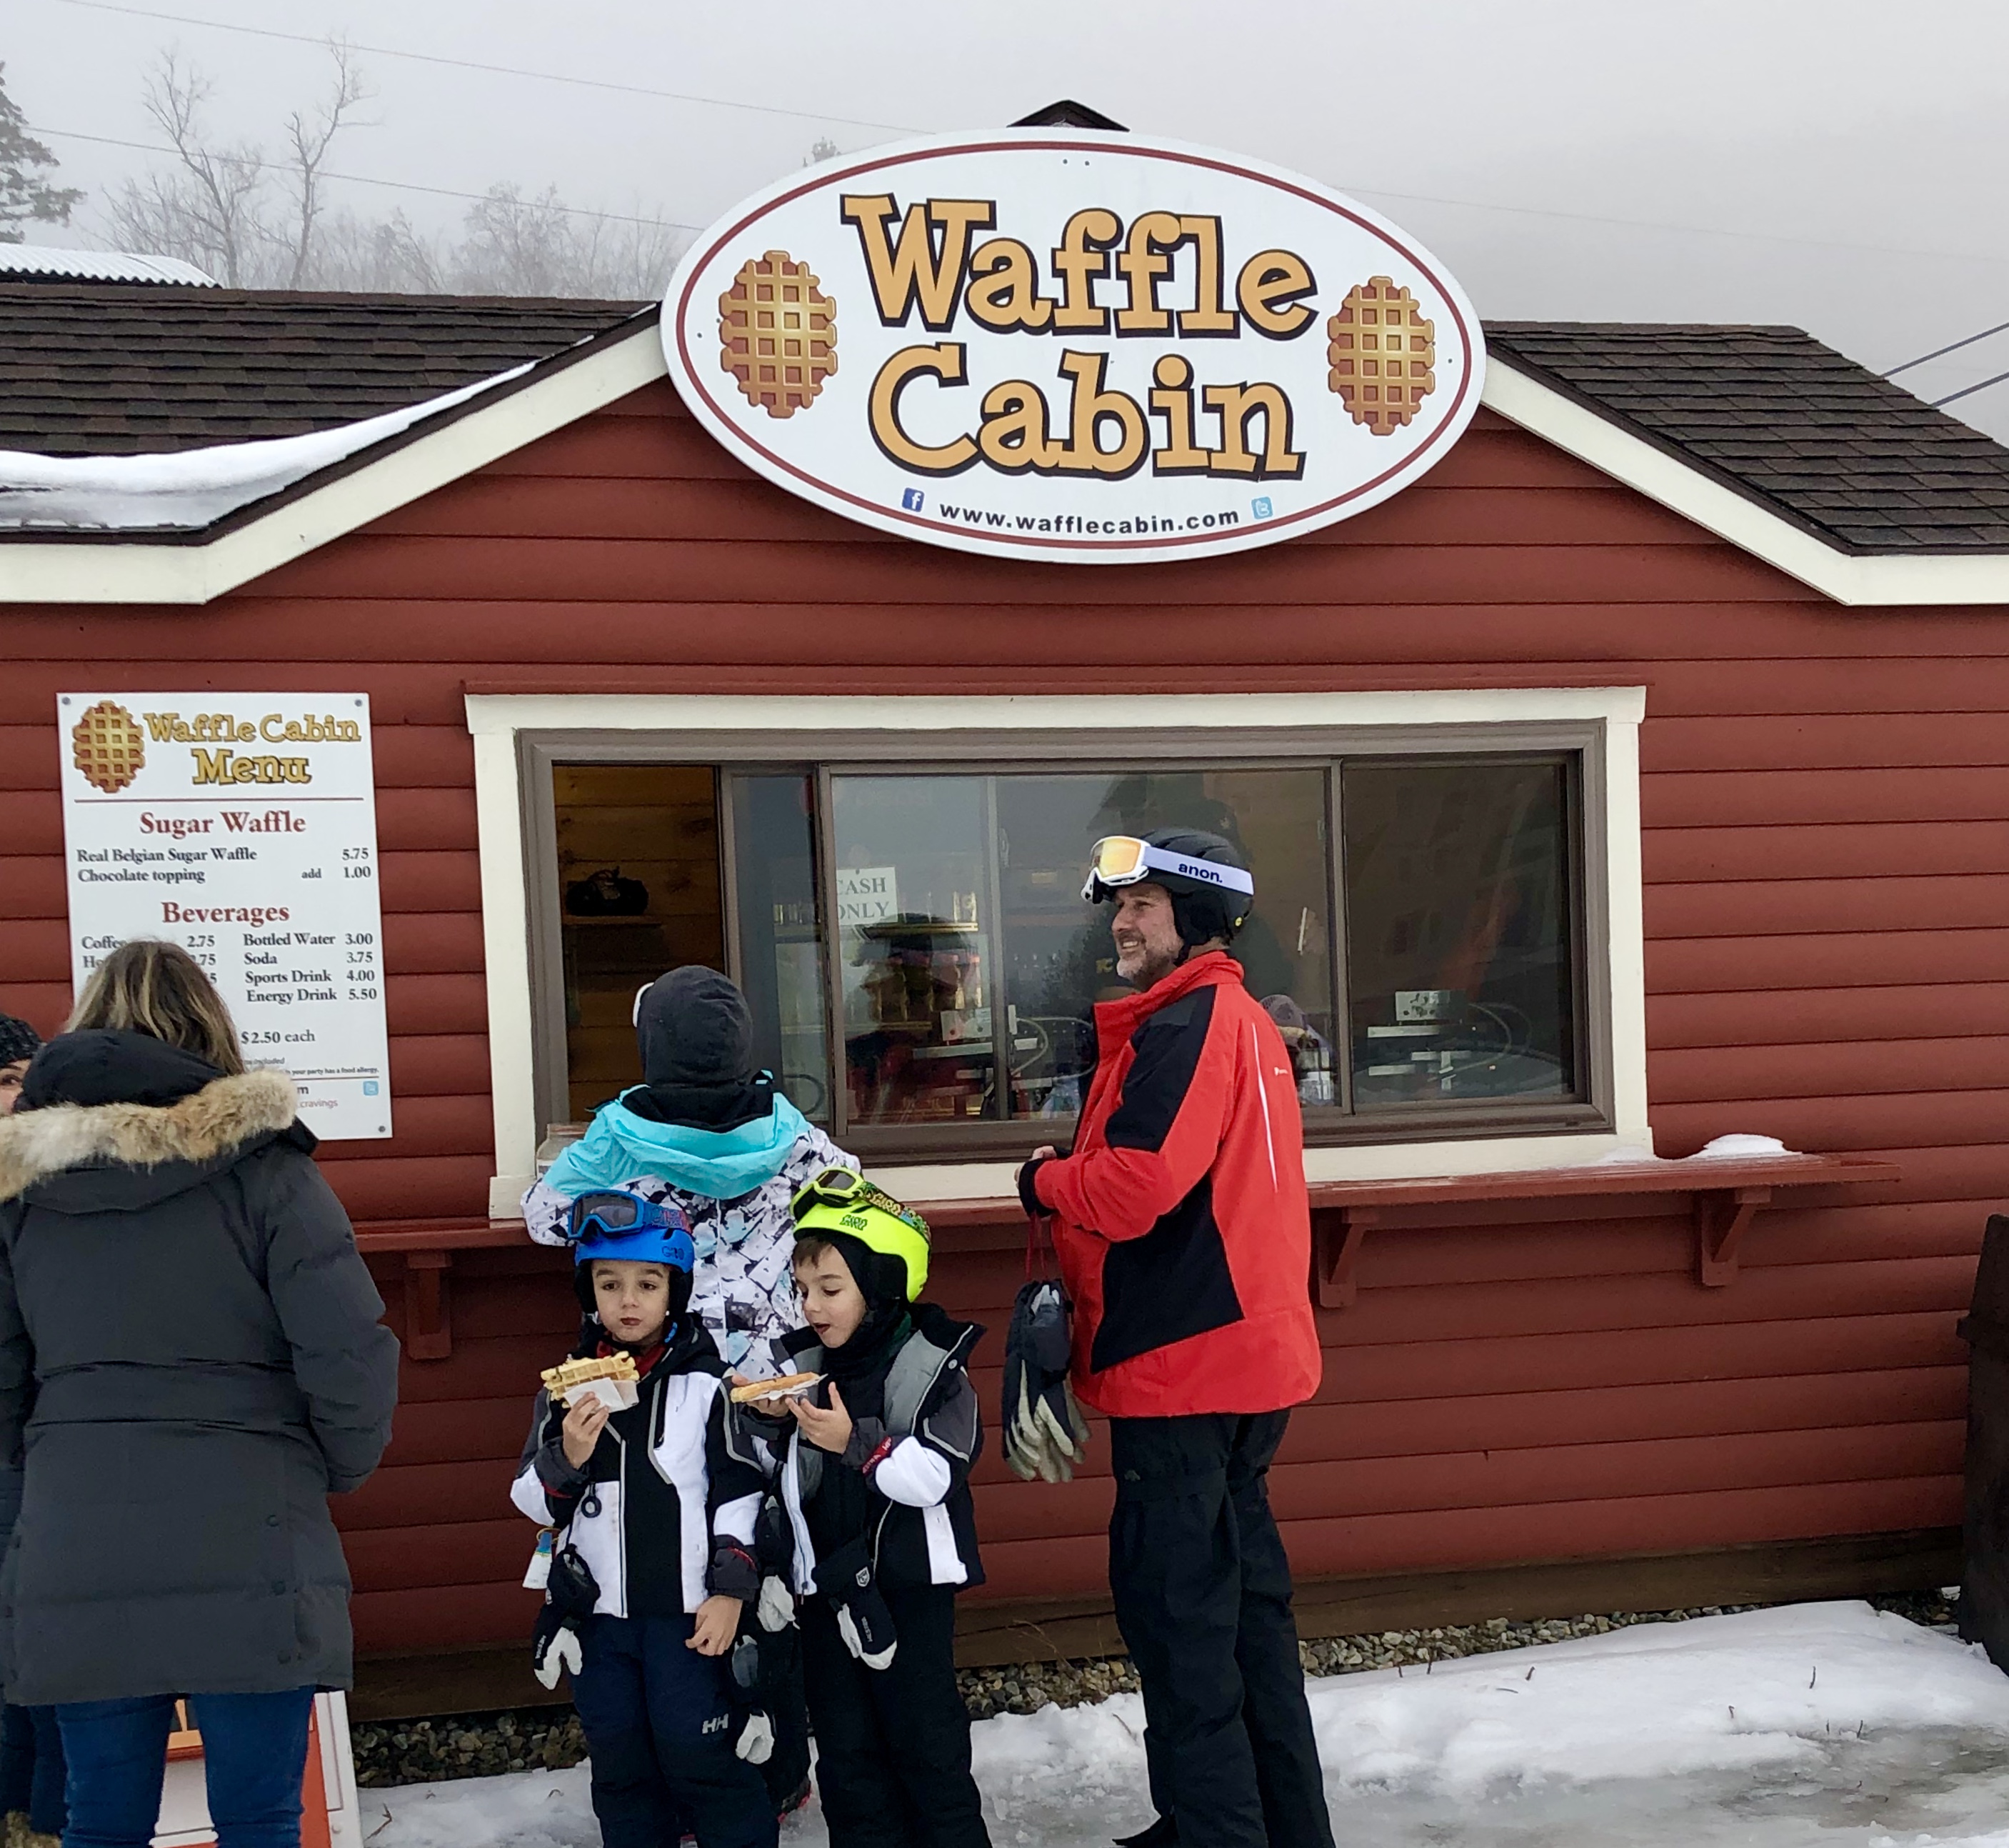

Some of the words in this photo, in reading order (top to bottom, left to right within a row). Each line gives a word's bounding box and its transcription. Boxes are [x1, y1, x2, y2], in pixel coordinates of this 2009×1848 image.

[840, 193, 1318, 341] Waffle
[867, 341, 1307, 482] Cabin
[940, 503, 1240, 534] www.wafflecabin.com
[144, 713, 256, 743] Waffle
[260, 714, 361, 743] Cabin
[191, 748, 313, 786] Menu
[140, 811, 213, 840] Sugar
[220, 810, 306, 833] Waffle
[76, 849, 108, 862] Real
[112, 848, 165, 865] Belgian
[168, 847, 208, 864] Sugar
[211, 847, 257, 861] Waffle
[342, 848, 369, 861] 5.75
[78, 868, 149, 882] Chocolate
[153, 868, 205, 884] topping
[301, 868, 322, 879] add
[344, 866, 371, 879] 1.00
[1178, 863, 1223, 883] anon.
[161, 901, 290, 928] Beverages
[187, 935, 215, 947] 2.75
[243, 932, 291, 946] Bottled
[294, 932, 336, 945] Water
[345, 933, 373, 945] 3.00
[83, 955, 105, 969] Ho
[244, 952, 277, 964] Soda
[346, 952, 373, 963] 3.75
[245, 971, 288, 987] Sports
[291, 969, 332, 982] Drink
[346, 969, 375, 982] 4.00
[246, 989, 294, 1005] Energy
[297, 988, 337, 1001] Drink
[349, 988, 376, 1000] 5.50
[284, 1029, 316, 1042] each
[300, 1099, 339, 1109] cravings
[869, 1192, 901, 1216] GIRO
[839, 1214, 868, 1231] GIRO
[702, 1713, 728, 1734] HH
